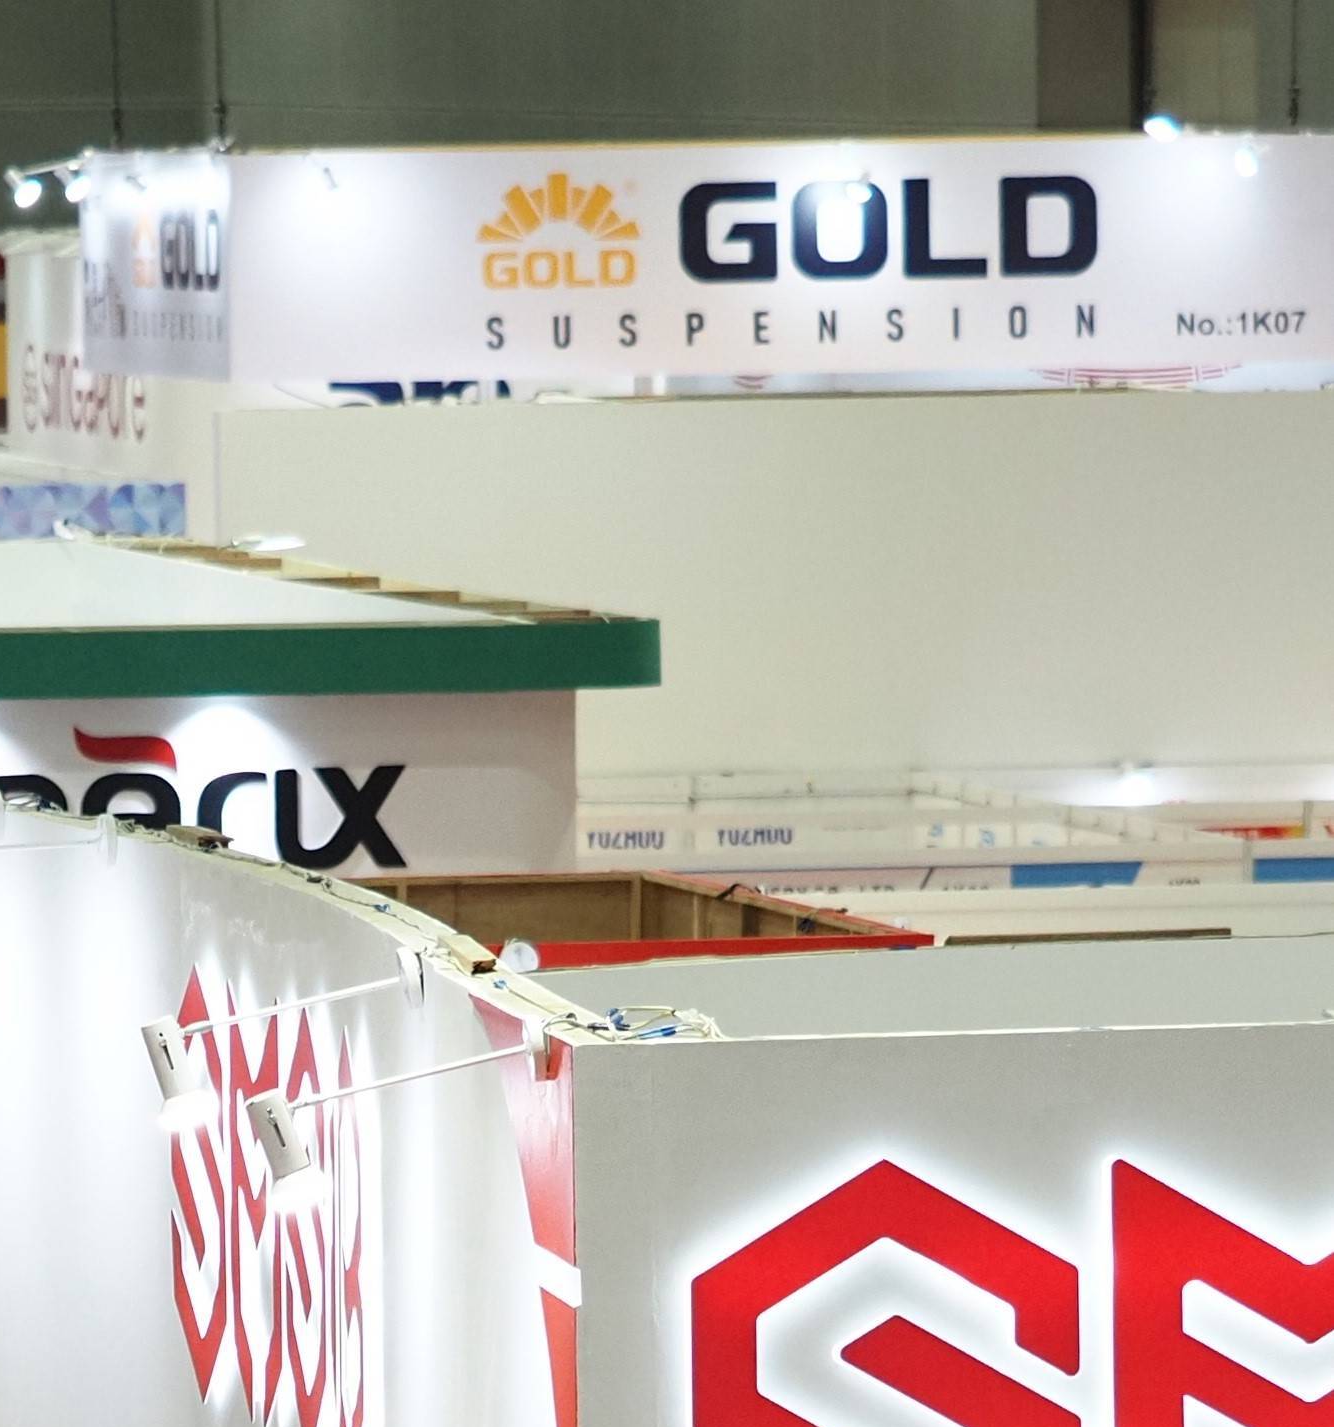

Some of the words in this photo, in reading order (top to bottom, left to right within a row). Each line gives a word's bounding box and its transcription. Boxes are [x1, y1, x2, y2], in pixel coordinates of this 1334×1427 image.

[679, 176, 1097, 283] GOLD
[483, 250, 635, 288] GOLD
[487, 305, 1096, 350] SUSPENSION
